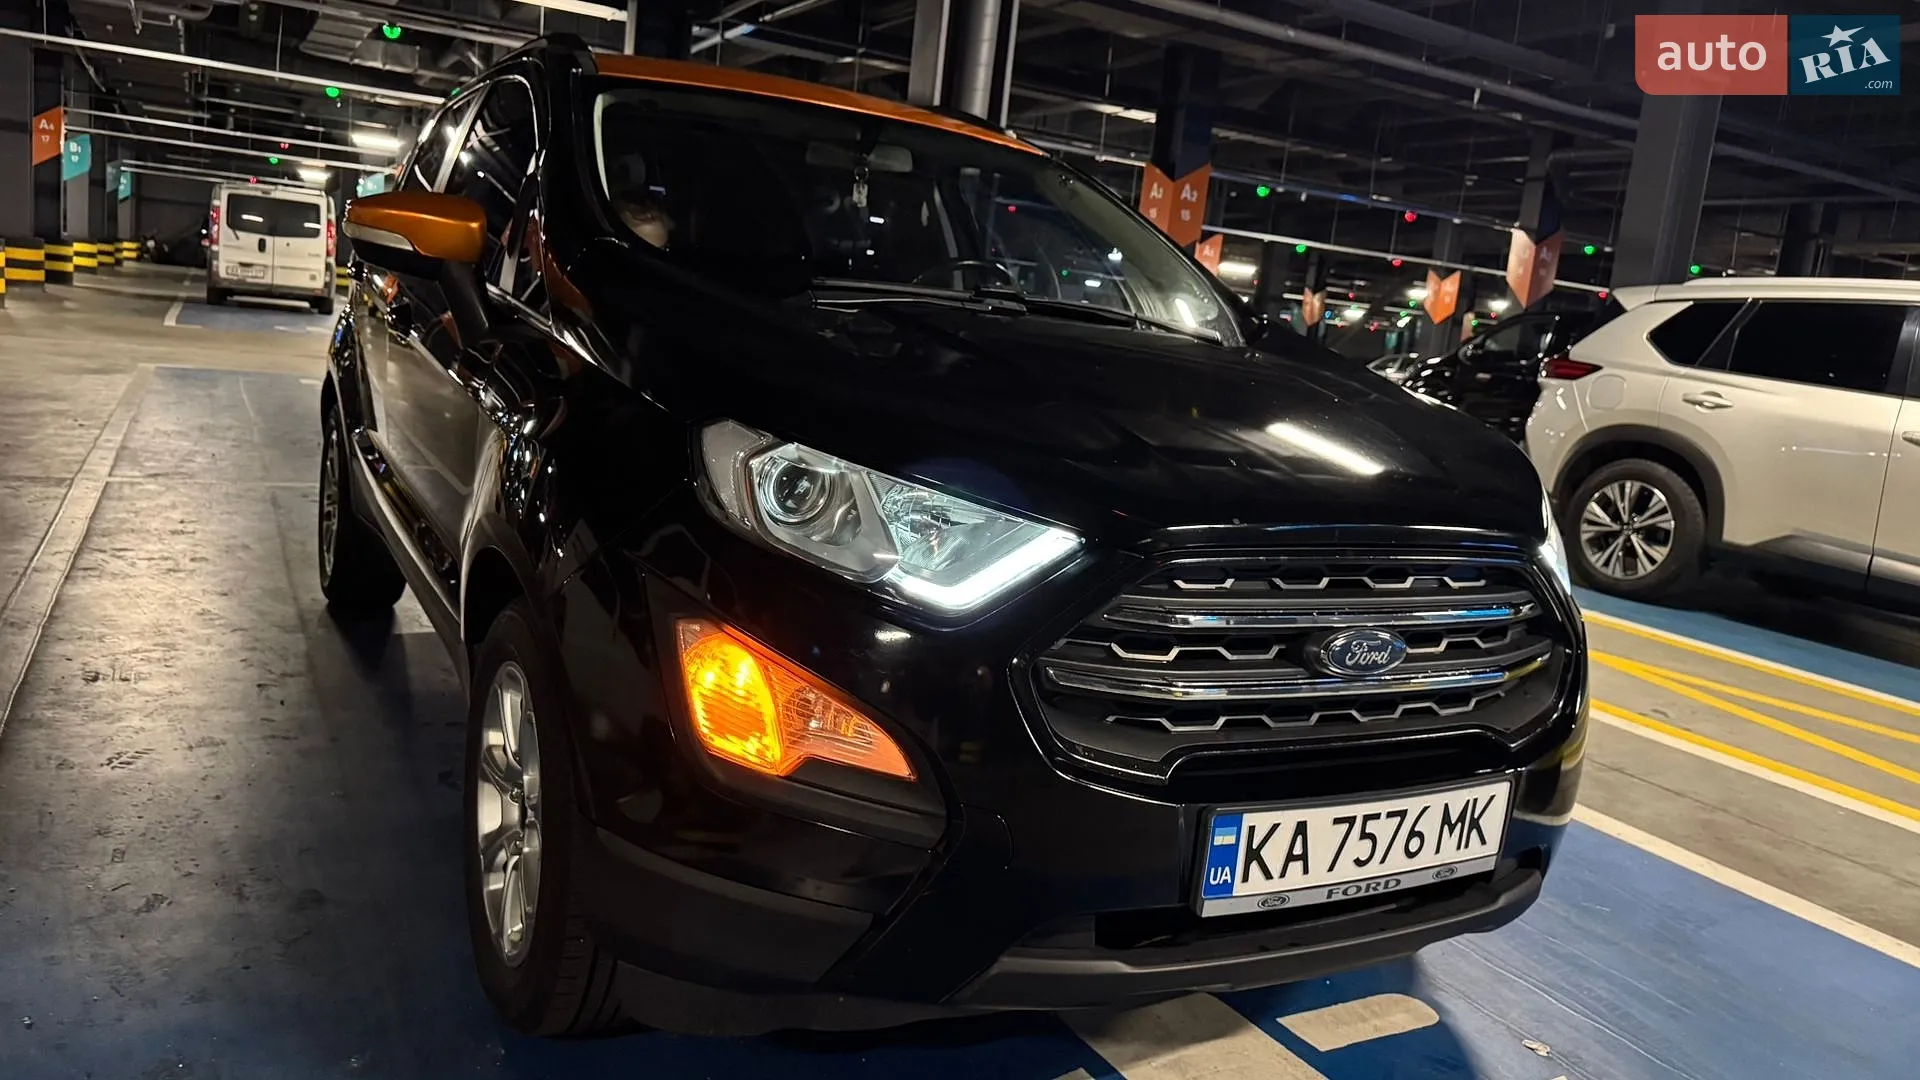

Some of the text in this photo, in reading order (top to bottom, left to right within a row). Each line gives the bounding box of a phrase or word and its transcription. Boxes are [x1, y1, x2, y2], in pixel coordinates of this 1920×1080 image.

[1345, 640, 1392, 666] Ford
[1241, 794, 1497, 883] KA 7576 MK
[1209, 866, 1232, 885] UA
[1326, 878, 1402, 899] FORD
